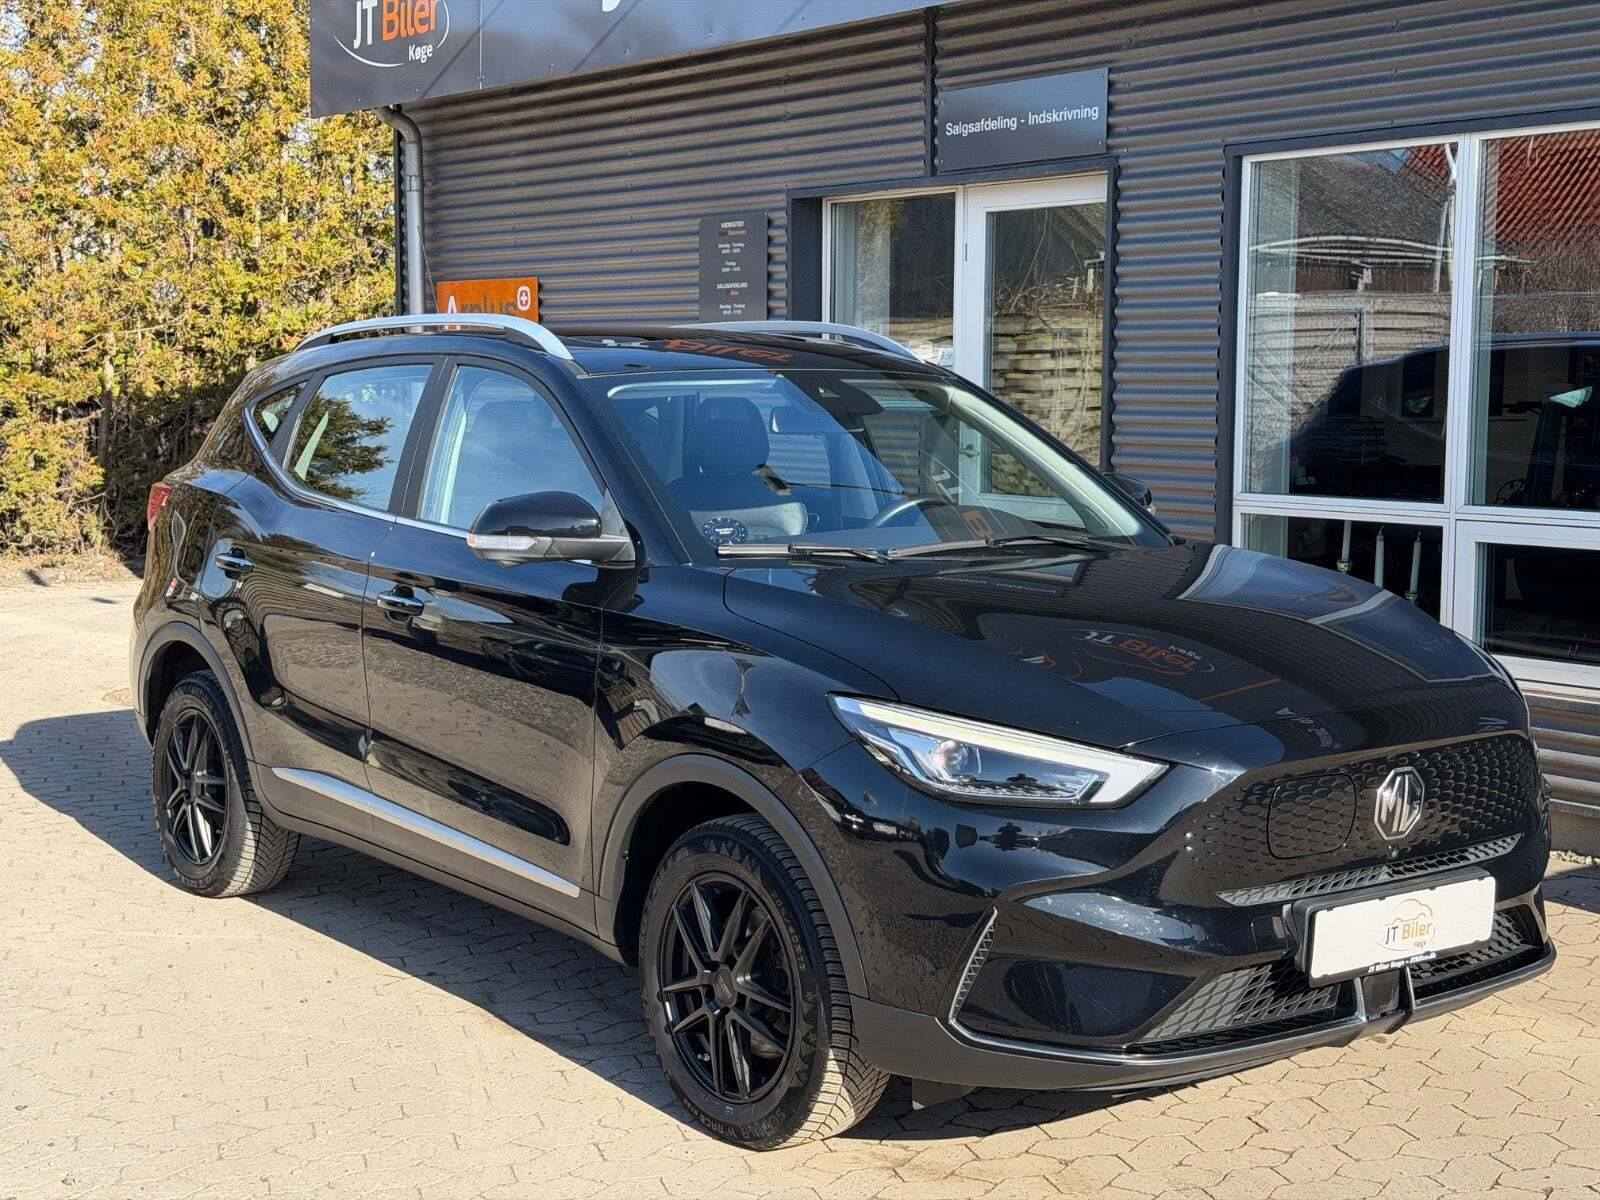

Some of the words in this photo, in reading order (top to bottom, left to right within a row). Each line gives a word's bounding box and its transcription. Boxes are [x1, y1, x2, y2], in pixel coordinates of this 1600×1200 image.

[353, 0, 378, 49] JT
[382, 0, 440, 41] Biler
[408, 44, 433, 63] Køge
[945, 115, 1017, 137] Salgsafdeling
[1028, 104, 1099, 126] Indskrivning
[1378, 770, 1423, 836] MG
[1402, 921, 1433, 940] Biler
